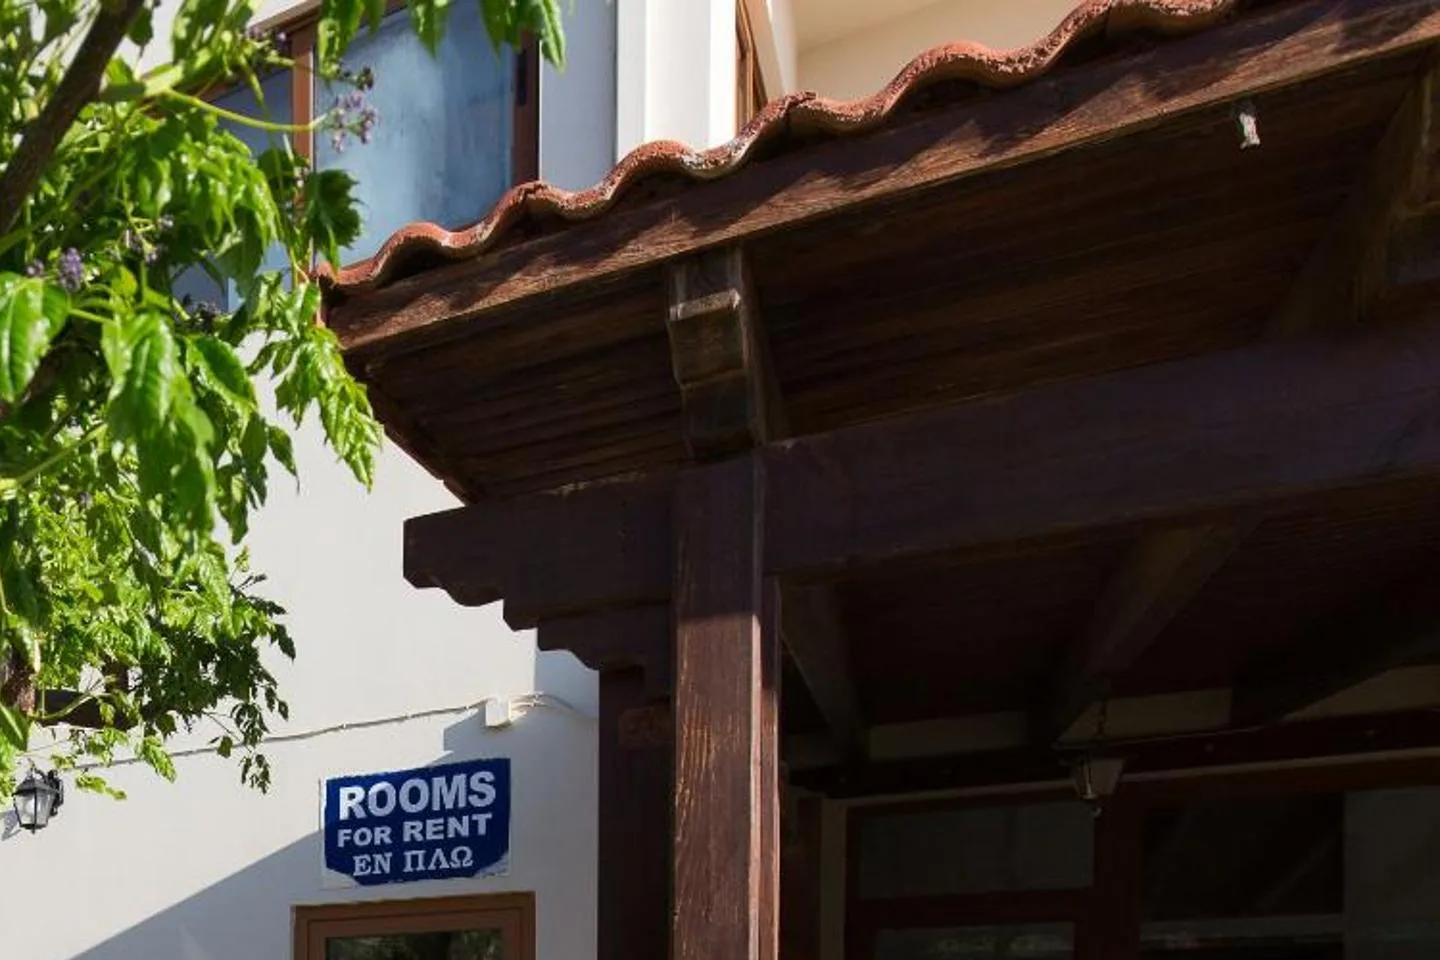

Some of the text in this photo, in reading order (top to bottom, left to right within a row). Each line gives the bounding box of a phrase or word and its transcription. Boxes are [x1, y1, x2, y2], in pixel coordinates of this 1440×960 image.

[339, 771, 496, 820] ROOMS
[337, 813, 492, 847] FOR RENT
